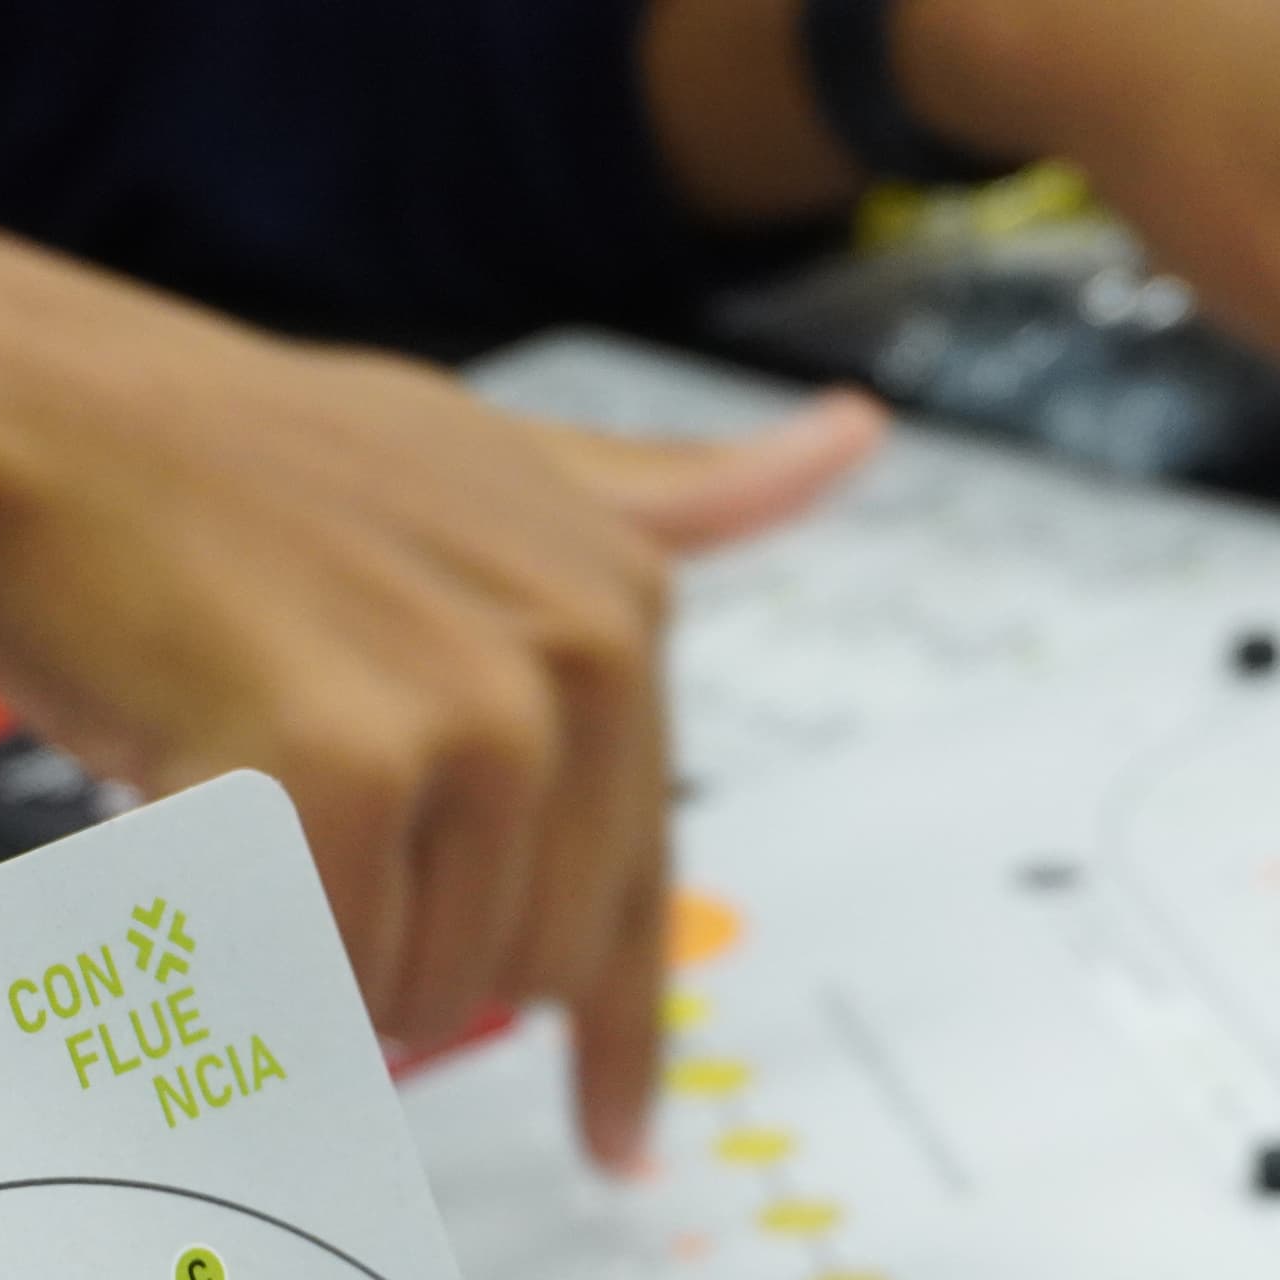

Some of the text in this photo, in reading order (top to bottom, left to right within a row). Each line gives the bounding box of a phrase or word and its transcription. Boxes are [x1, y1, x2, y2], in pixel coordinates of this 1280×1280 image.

[8, 945, 124, 1033] CON
[65, 987, 209, 1089] FLUE
[152, 1034, 287, 1128] NCIA
